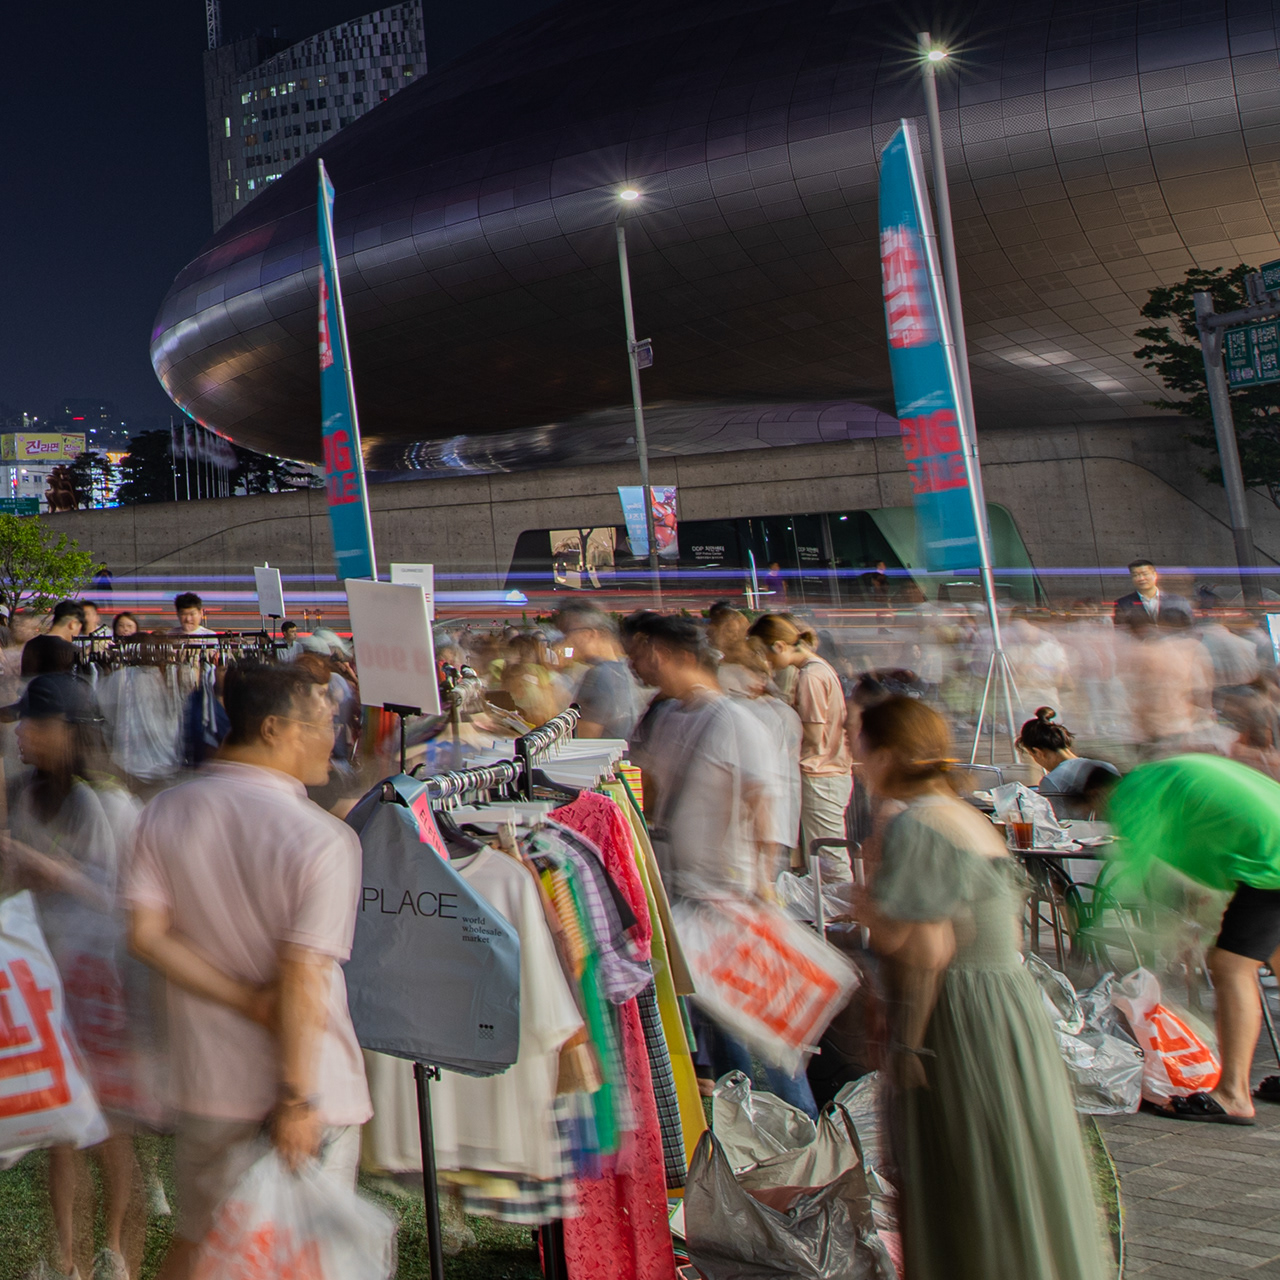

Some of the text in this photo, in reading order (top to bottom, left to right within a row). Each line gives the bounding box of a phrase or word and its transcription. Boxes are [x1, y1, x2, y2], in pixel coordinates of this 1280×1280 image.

[25, 440, 59, 455] 진라면
[362, 887, 458, 919] PLACE
[462, 917, 485, 925] world
[462, 926, 502, 937] wholesale
[462, 936, 490, 944] market
